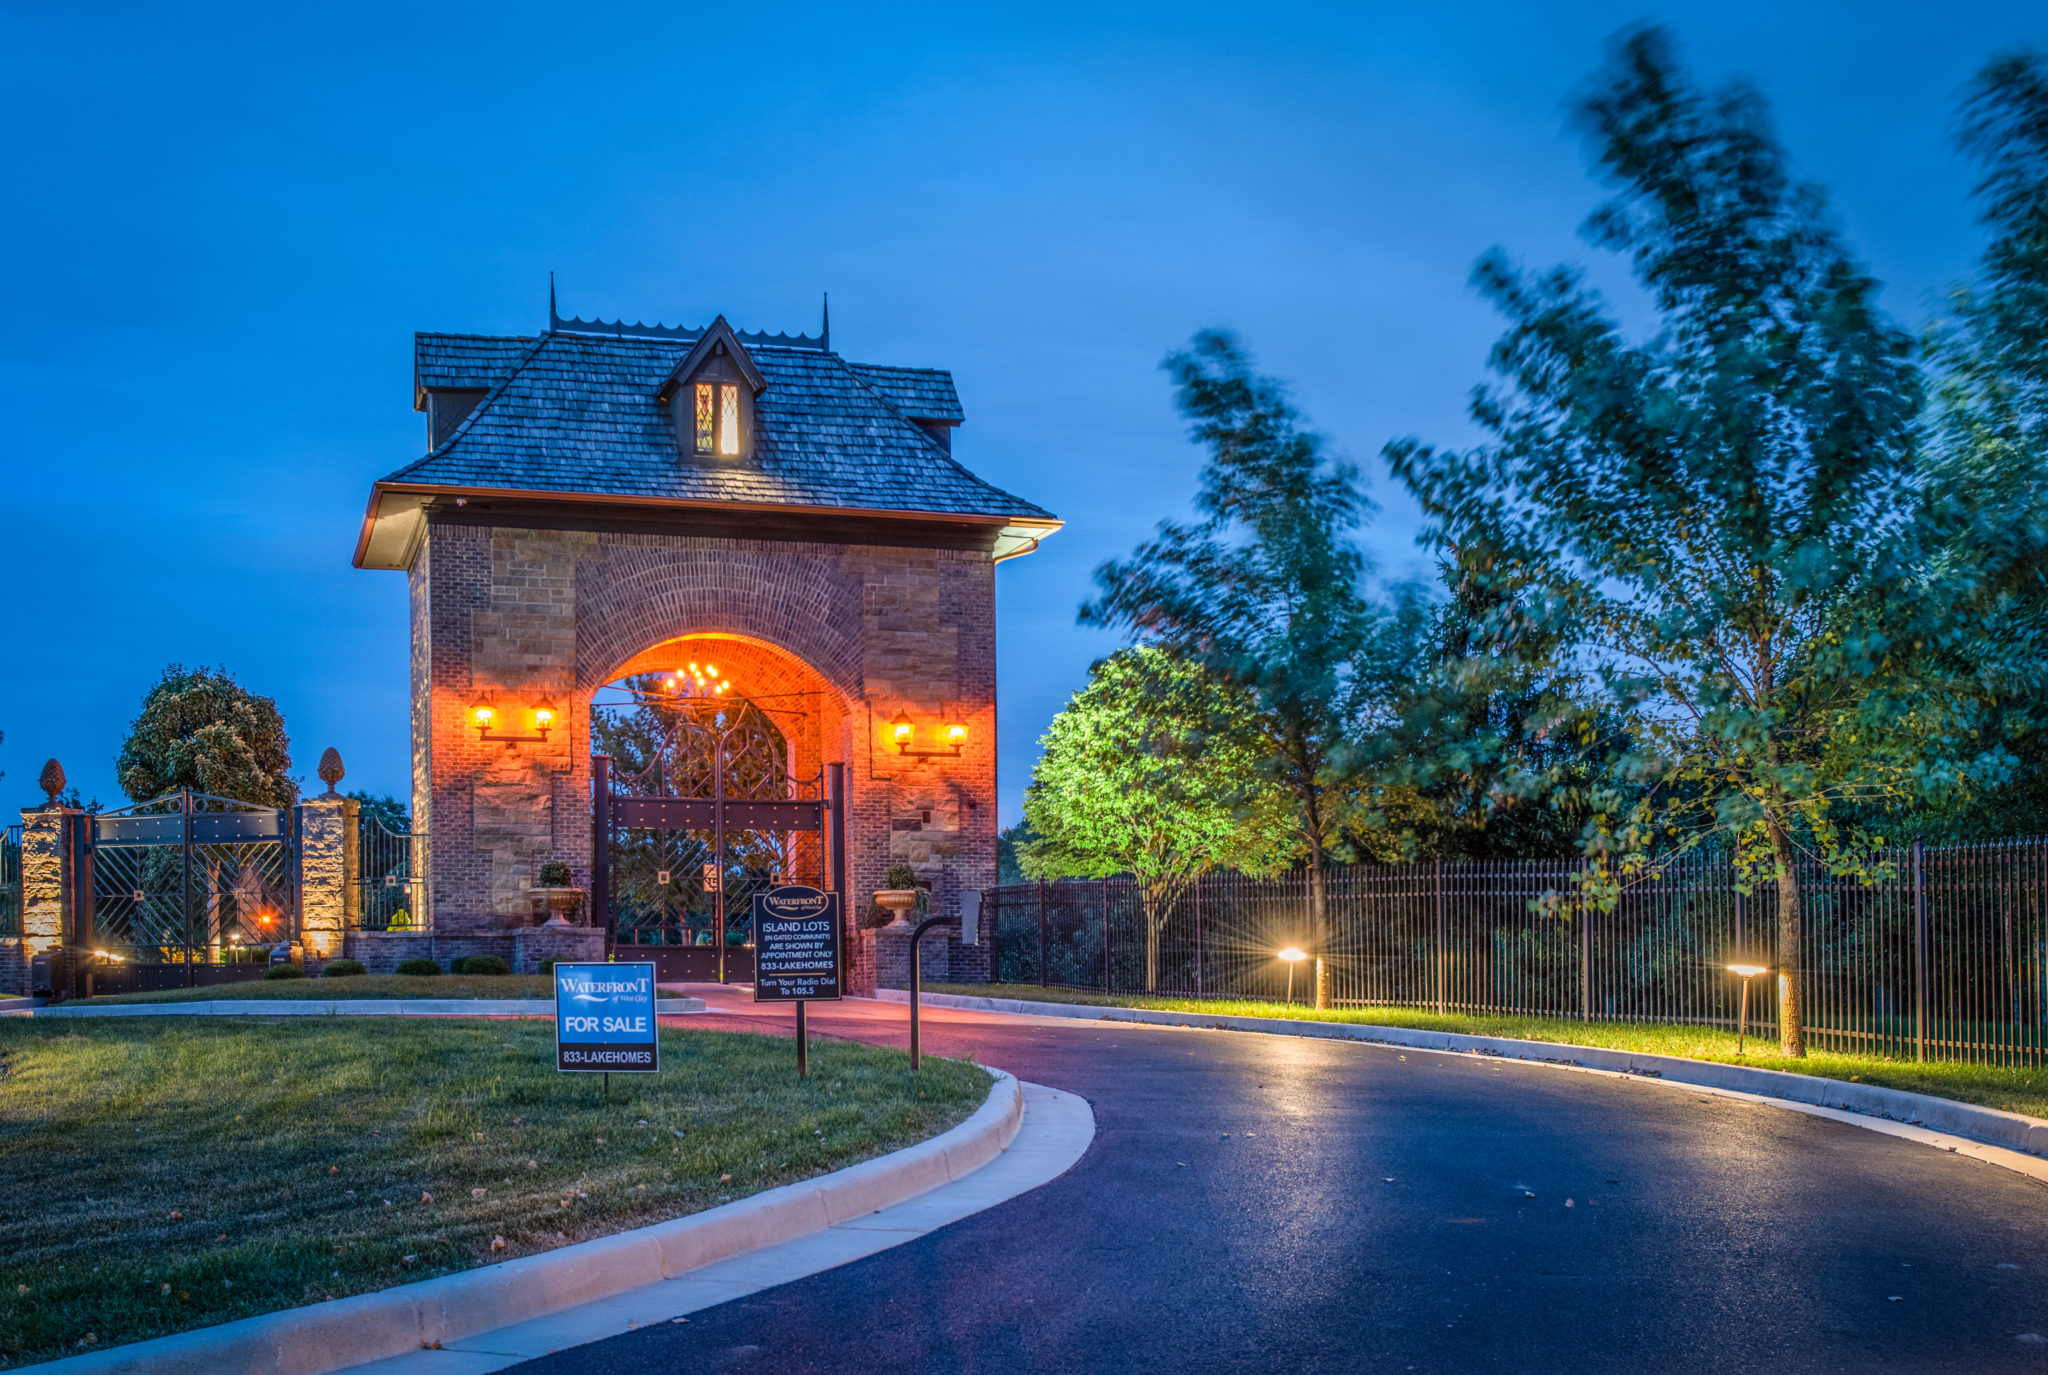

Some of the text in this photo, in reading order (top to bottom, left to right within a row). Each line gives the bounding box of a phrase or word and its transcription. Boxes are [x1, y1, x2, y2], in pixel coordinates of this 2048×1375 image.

[769, 896, 823, 905] WATERFRONT
[762, 921, 830, 932] ISLAND LOTS
[769, 942, 784, 950] ARE
[814, 941, 824, 949] BY
[761, 950, 833, 959] APPOINTMENT ONLY
[761, 961, 834, 970] 833-LAKEHOMES
[560, 978, 650, 993] WATERFRONT
[760, 976, 836, 987] Turn Your Radio Dial
[780, 986, 815, 995] To 105.5
[565, 1016, 647, 1033] FOR SALE
[563, 1051, 652, 1064] 833-LAKEHOMES
